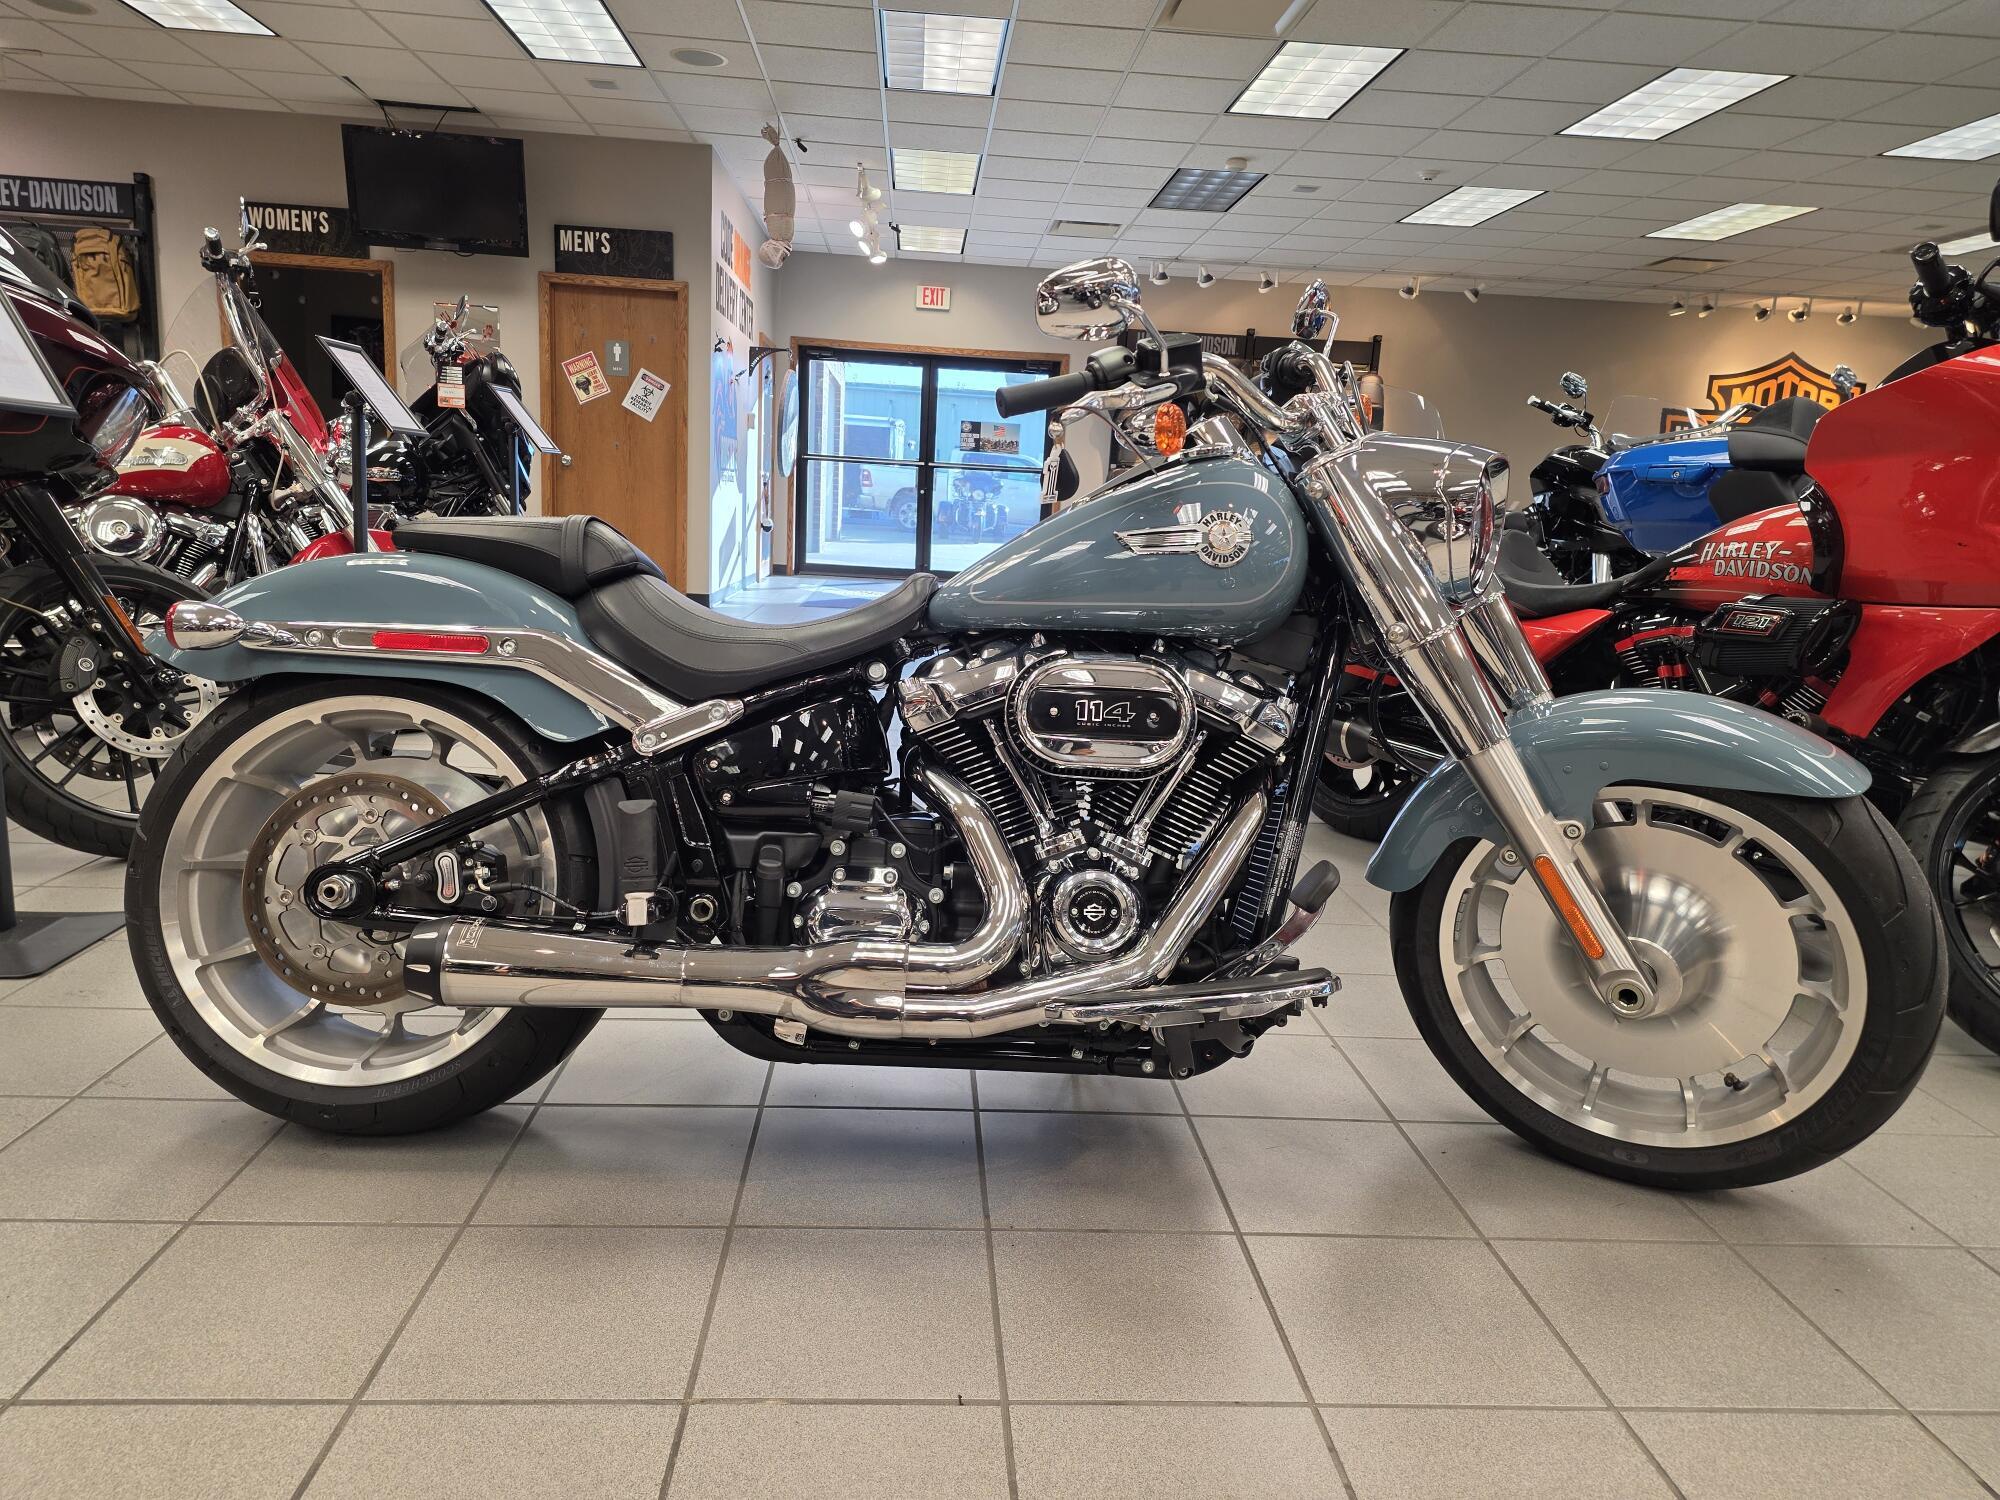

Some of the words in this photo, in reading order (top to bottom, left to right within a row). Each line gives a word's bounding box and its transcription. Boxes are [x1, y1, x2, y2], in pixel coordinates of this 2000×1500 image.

[0, 178, 118, 213] EY-DAVIDSON
[248, 206, 329, 234] WOMEN'S
[560, 229, 611, 254] MEN'S
[922, 287, 946, 306] EXIT
[567, 356, 594, 374] WARNING
[629, 401, 649, 413] FACILITY
[630, 397, 653, 411] RESEARCH
[635, 394, 652, 406] ZOMBIE
[1201, 545, 1246, 564] DAVIDSON
[1713, 559, 1813, 586] DAVIDSON
[1733, 614, 1771, 628] 121
[1075, 699, 1136, 723] 114
